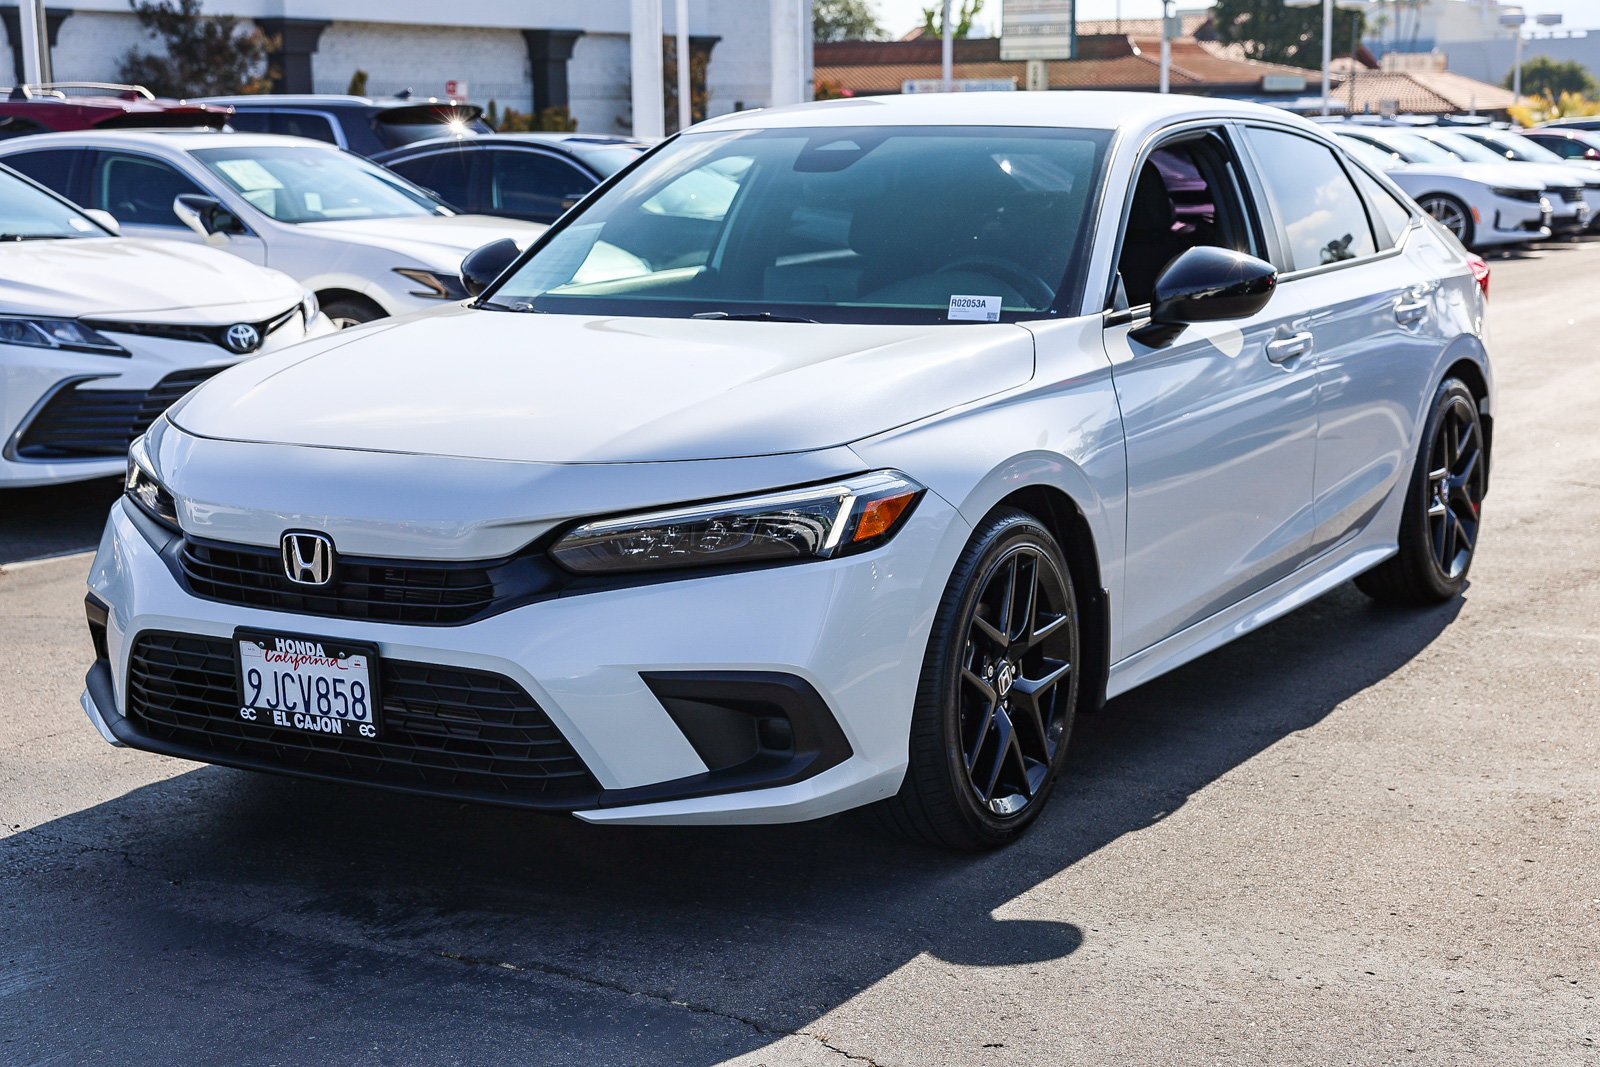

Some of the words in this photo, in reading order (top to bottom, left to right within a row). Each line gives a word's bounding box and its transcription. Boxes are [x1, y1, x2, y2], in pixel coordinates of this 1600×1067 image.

[951, 298, 986, 308] R02053A
[274, 637, 326, 658] HONDA
[264, 649, 348, 671] California
[247, 668, 367, 721] 9JCV858
[273, 710, 291, 727] EL
[293, 713, 343, 734] CAJON
